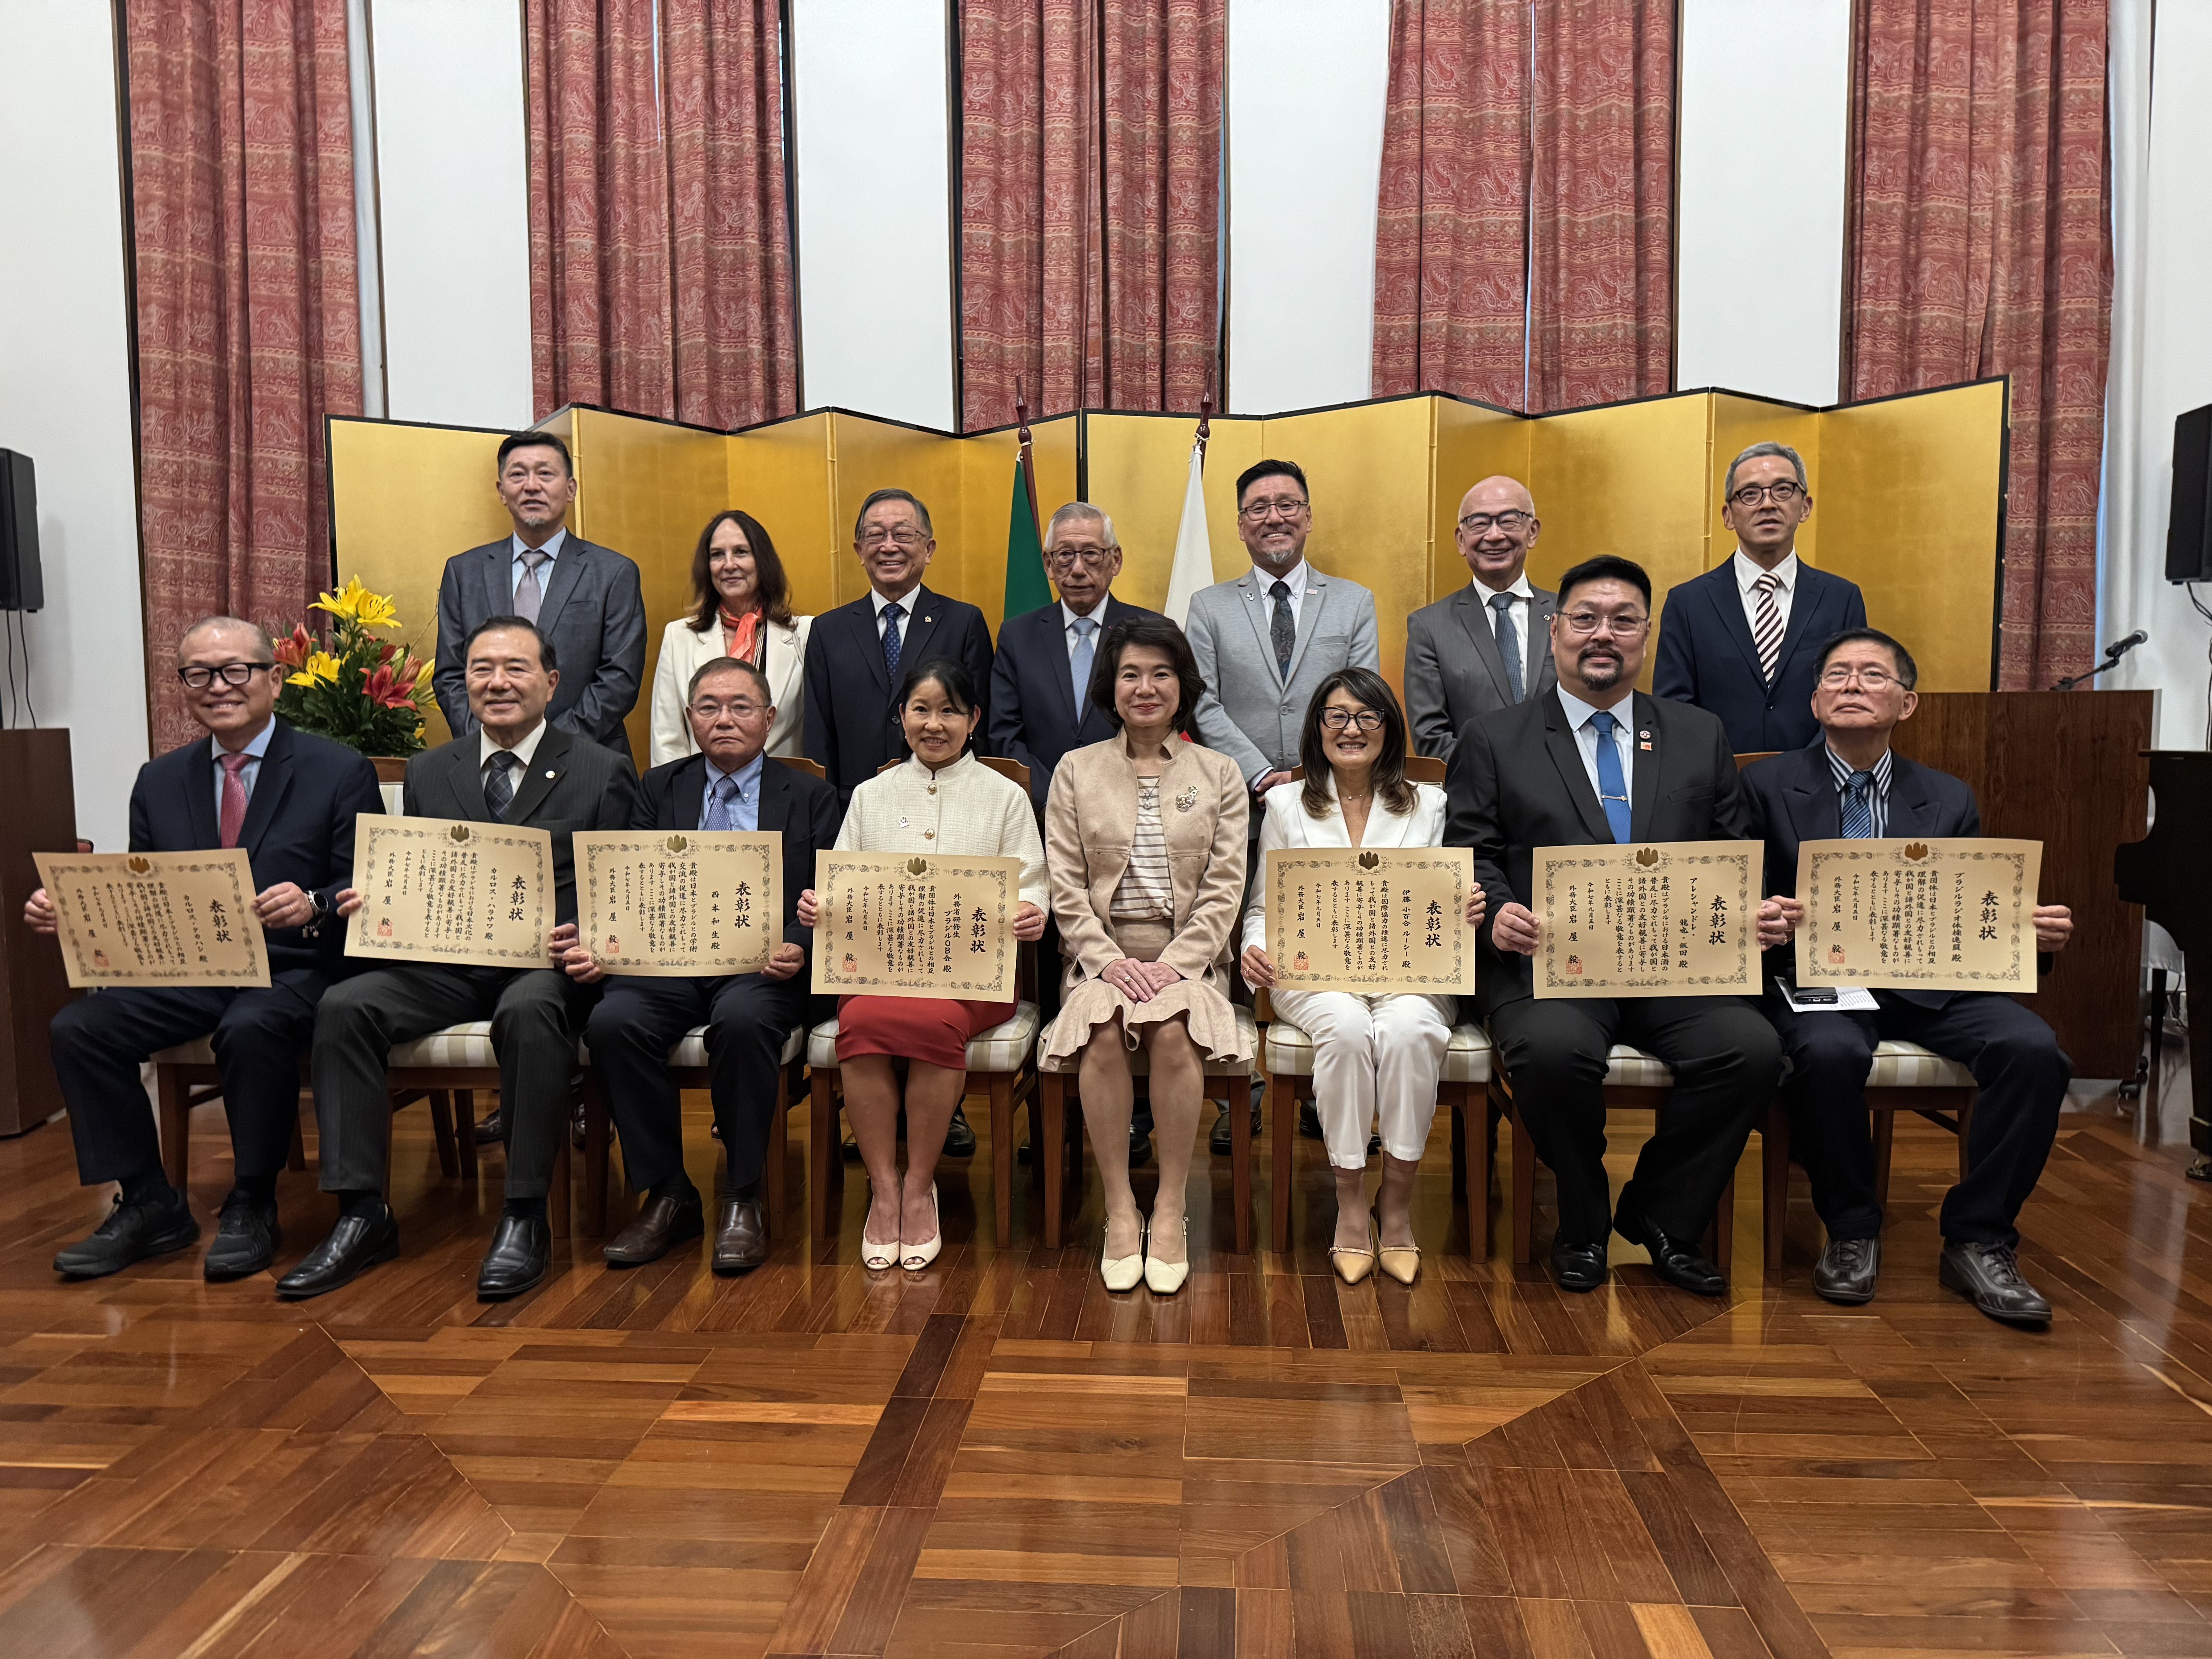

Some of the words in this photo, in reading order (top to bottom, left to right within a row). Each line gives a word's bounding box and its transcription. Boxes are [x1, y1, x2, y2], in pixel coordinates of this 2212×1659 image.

[184, 895, 203, 951] カルロス・タカハシ
[210, 899, 233, 943] 表彰状
[486, 867, 497, 929] カルロス・ハラサワ
[509, 874, 527, 921] 表彰状
[668, 862, 677, 952] 我が国と諸外国との友好親善に
[679, 862, 687, 952] 交流の促進に尽力されもって
[689, 862, 698, 952] 貴殿は日本とブラジルとの学術
[734, 881, 751, 928] 表彰状
[877, 883, 885, 951] 表するとともに表彰します
[897, 884, 905, 972] 寄与しその功績顕著なものが
[907, 885, 915, 972] 我が国と諸外国との友好親善に
[917, 886, 926, 973] 理解の促進に尽力されもって
[927, 885, 936, 974] 貴団体は日本とブラジルとの相互
[953, 893, 962, 938] 外務省研修生
[970, 907, 987, 953] 表彰状
[1331, 880, 1339, 949] 表するとともに表彰します
[1356, 880, 1364, 970] 親善に寄与しその功績顕著なものが
[1368, 880, 1376, 970] もって我が国と諸外国との友好
[1380, 880, 1389, 970] 貴殿は国際協力の推進に尽力され
[1402, 890, 1411, 903] 伊藤
[1402, 907, 1411, 927] 小百合
[1425, 900, 1442, 948] 表彰状
[1604, 878, 1613, 925] ともに表彰します
[1615, 878, 1624, 973] ここに深甚なる敬意を表すると
[1626, 878, 1635, 972] その功績顕著なものがあります
[1638, 877, 1647, 972] 諸外国との友好親善に寄与し
[1649, 877, 1658, 971] 普及に尽力されもって我が国と
[1661, 876, 1670, 971] 貴殿はブラジルにおける日本酒の
[1690, 878, 1698, 936] アレシャンドレ・
[1708, 895, 1728, 946] 表彰状
[1869, 870, 1879, 942] 表するとともに表彰します
[1903, 870, 1915, 963] 我が国と諸外国との友好親善に
[1916, 871, 1926, 964] 理解の促進に尽力されもって
[1927, 870, 1939, 964] 貴団体は日本とブラジルとの相互
[1952, 872, 1965, 951] ブラジルラジオ体操連盟
[1979, 890, 1999, 941] 表彰状
[1951, 954, 1962, 962] 殿
